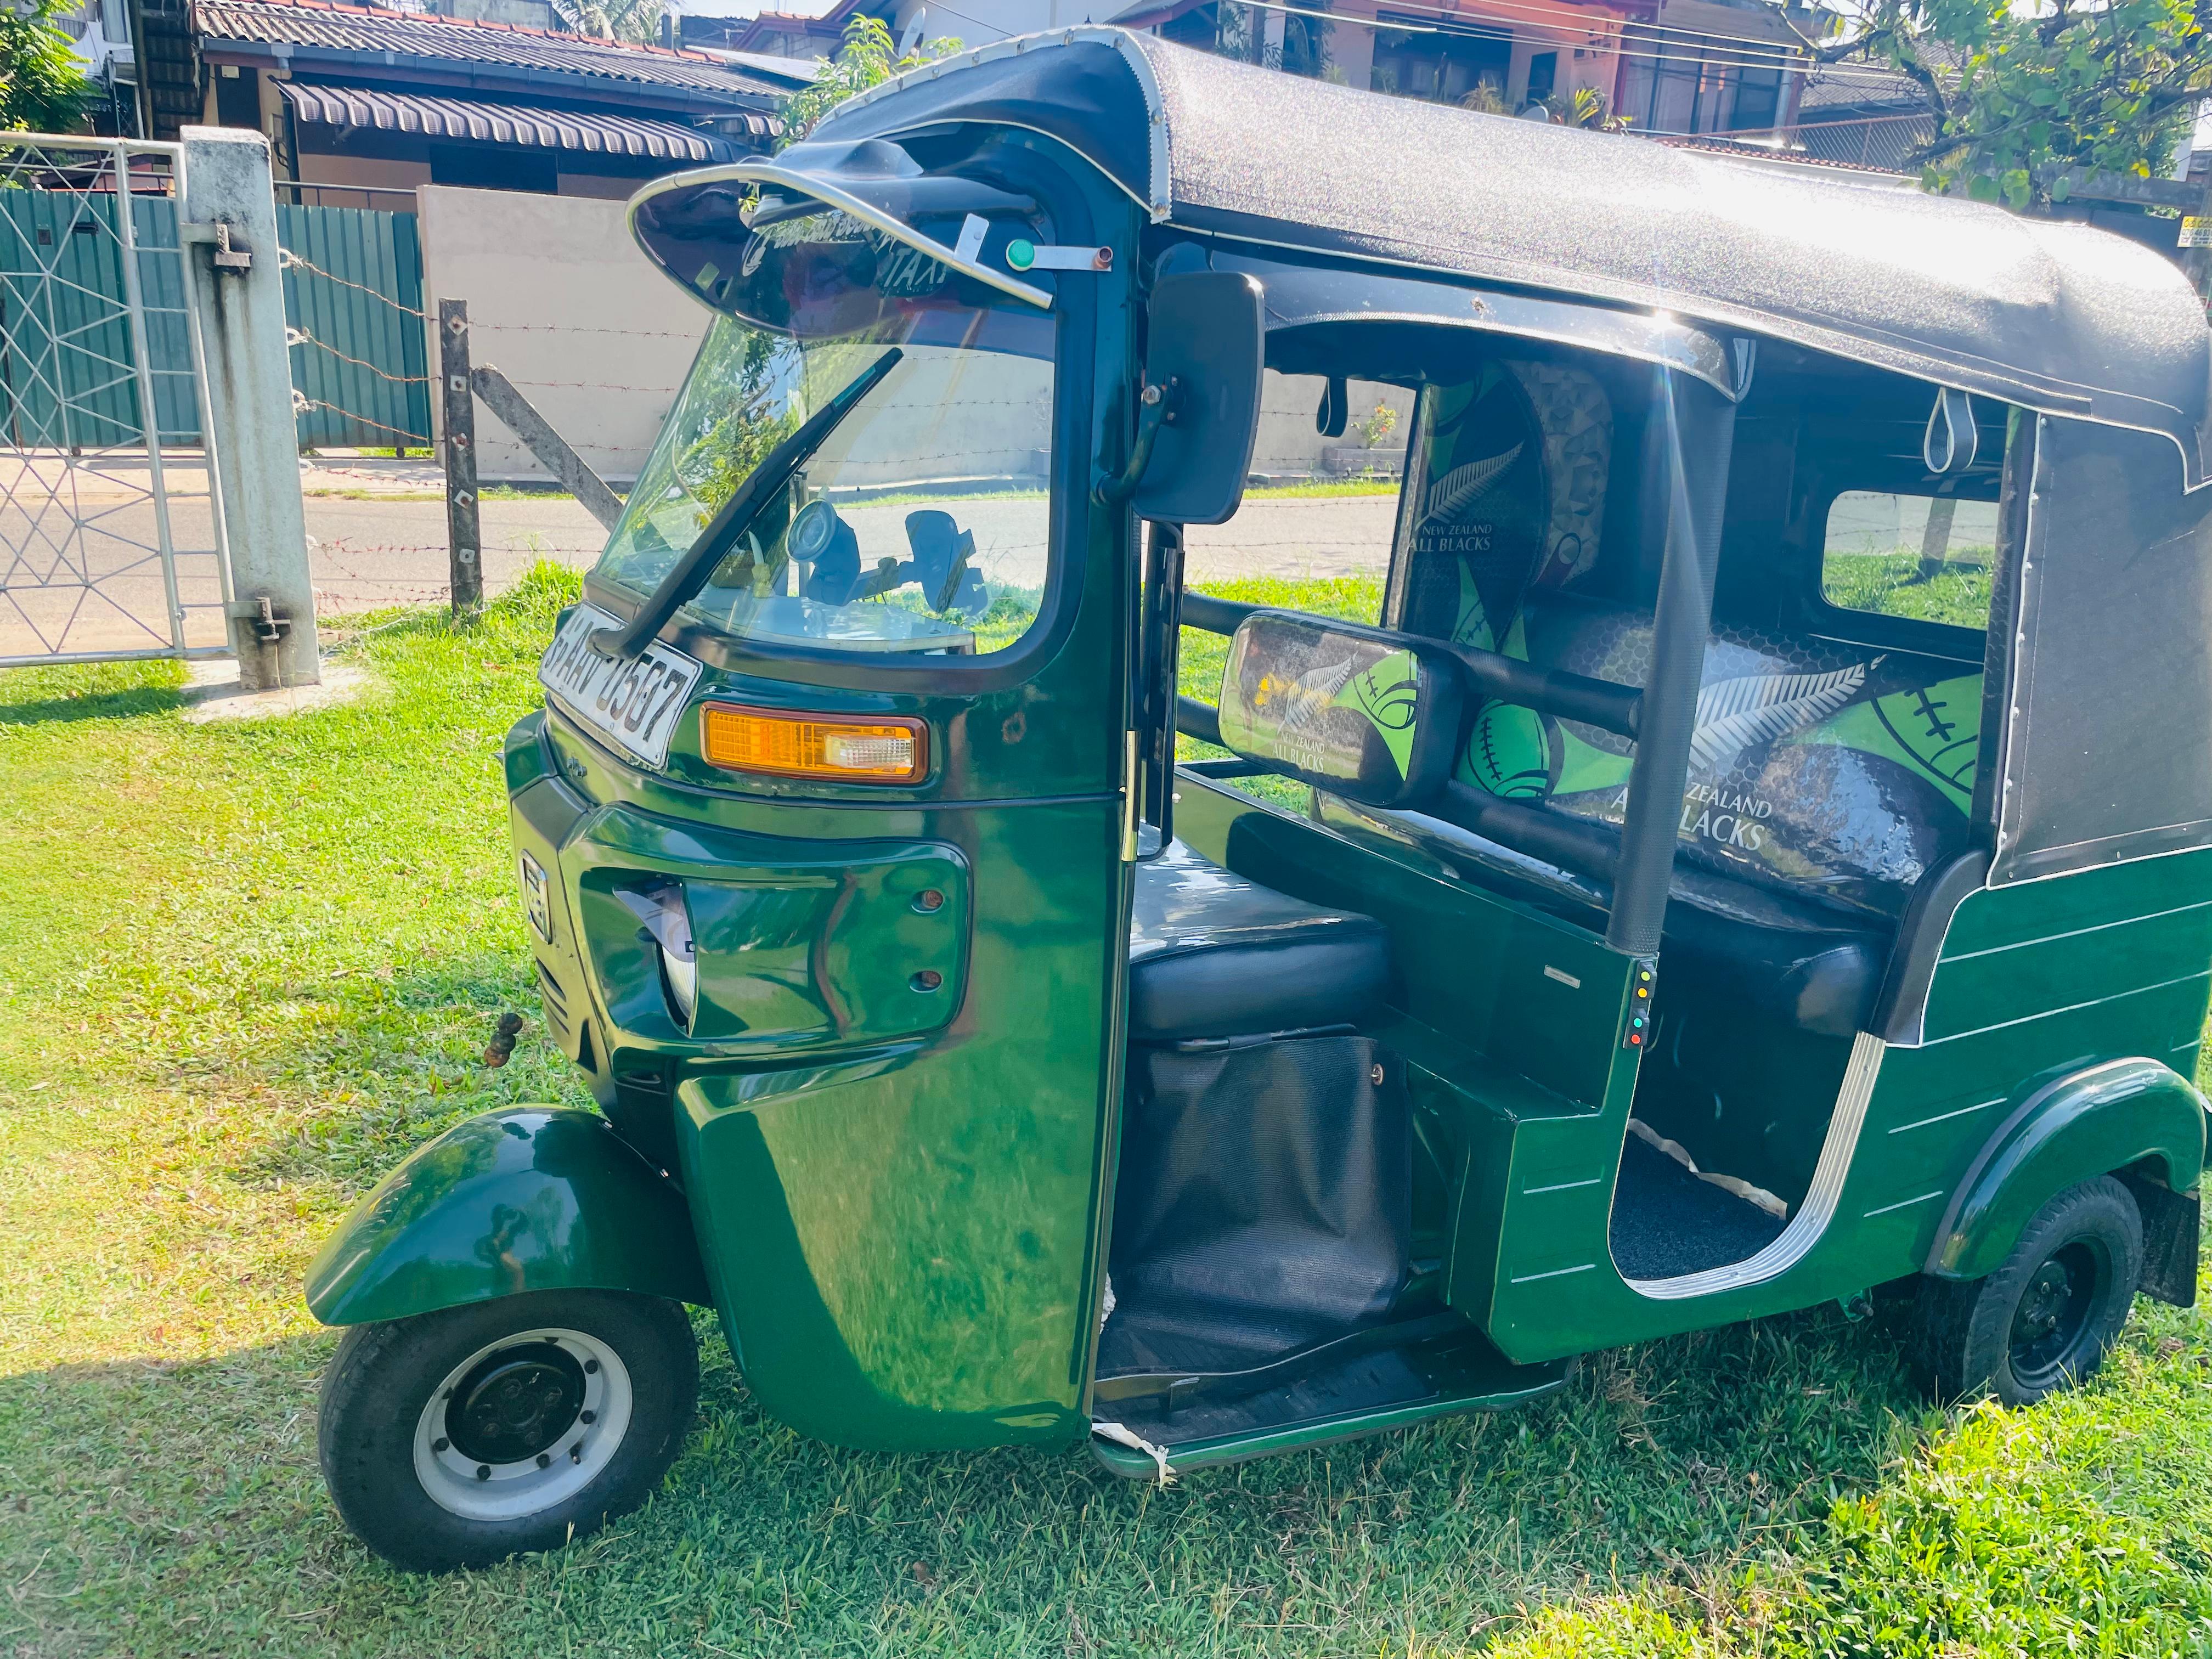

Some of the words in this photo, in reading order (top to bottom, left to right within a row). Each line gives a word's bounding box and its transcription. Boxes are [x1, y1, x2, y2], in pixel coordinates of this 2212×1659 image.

[1422, 525, 1447, 536] NEW
[1448, 524, 1492, 535] ZEALAND
[1408, 538, 1434, 552] ALL
[1439, 537, 1491, 552] BLACKS
[1281, 730, 1295, 745] NEW
[1296, 736, 1325, 754] ZEALAND
[1273, 742, 1289, 761] ALL
[1290, 748, 1324, 773] BLACKS
[1686, 781, 1773, 819] ZEALAND
[1679, 804, 1765, 851] LACKS
